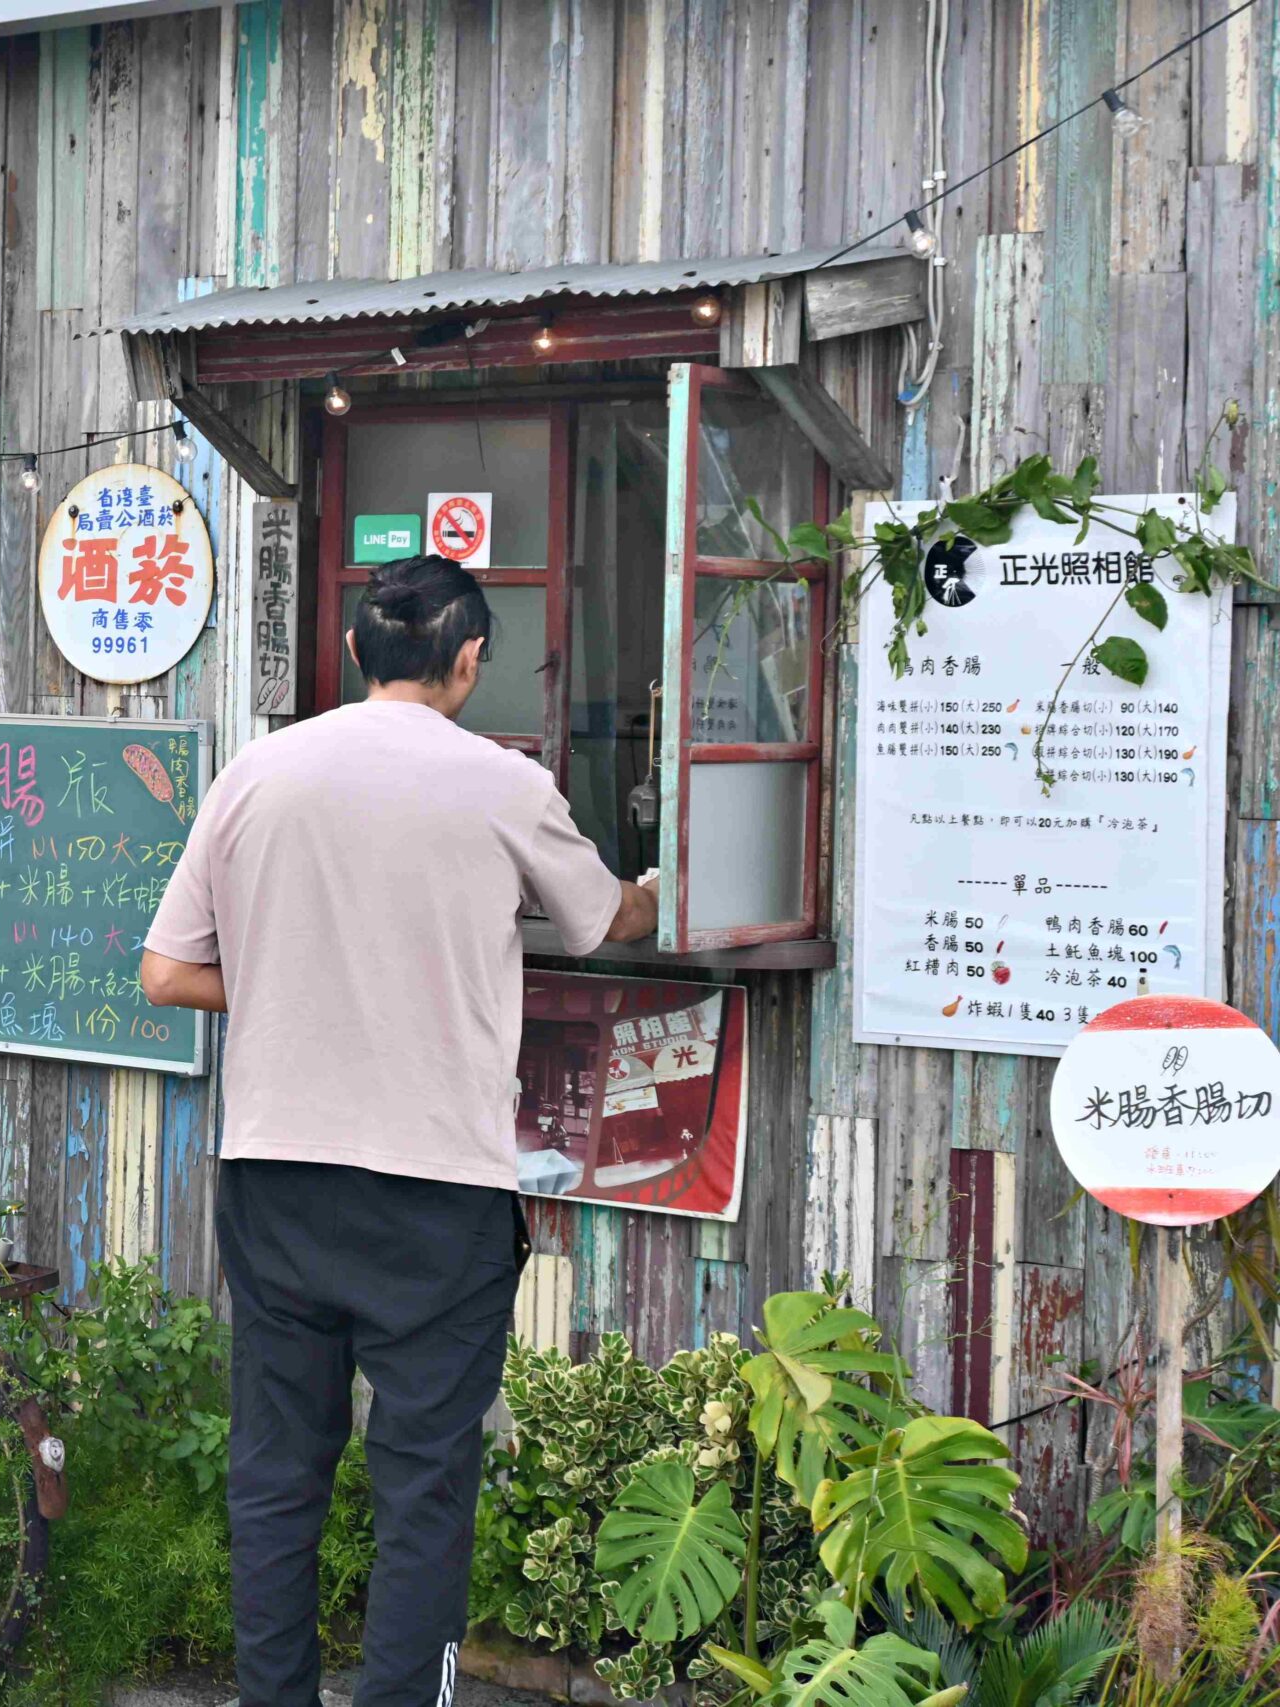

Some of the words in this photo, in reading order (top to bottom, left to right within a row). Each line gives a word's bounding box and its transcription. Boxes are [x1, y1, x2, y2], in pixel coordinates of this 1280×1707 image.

[363, 534, 387, 545] LINE
[391, 533, 408, 547] Pay
[933, 564, 948, 580] 正
[999, 550, 1155, 587] 正光照相館
[257, 509, 293, 681] 米腸香腸切
[92, 636, 149, 654] 99961
[130, 1015, 170, 1042] 100
[672, 1044, 699, 1068] 光
[1074, 1081, 1273, 1131] 米腸香腸切
